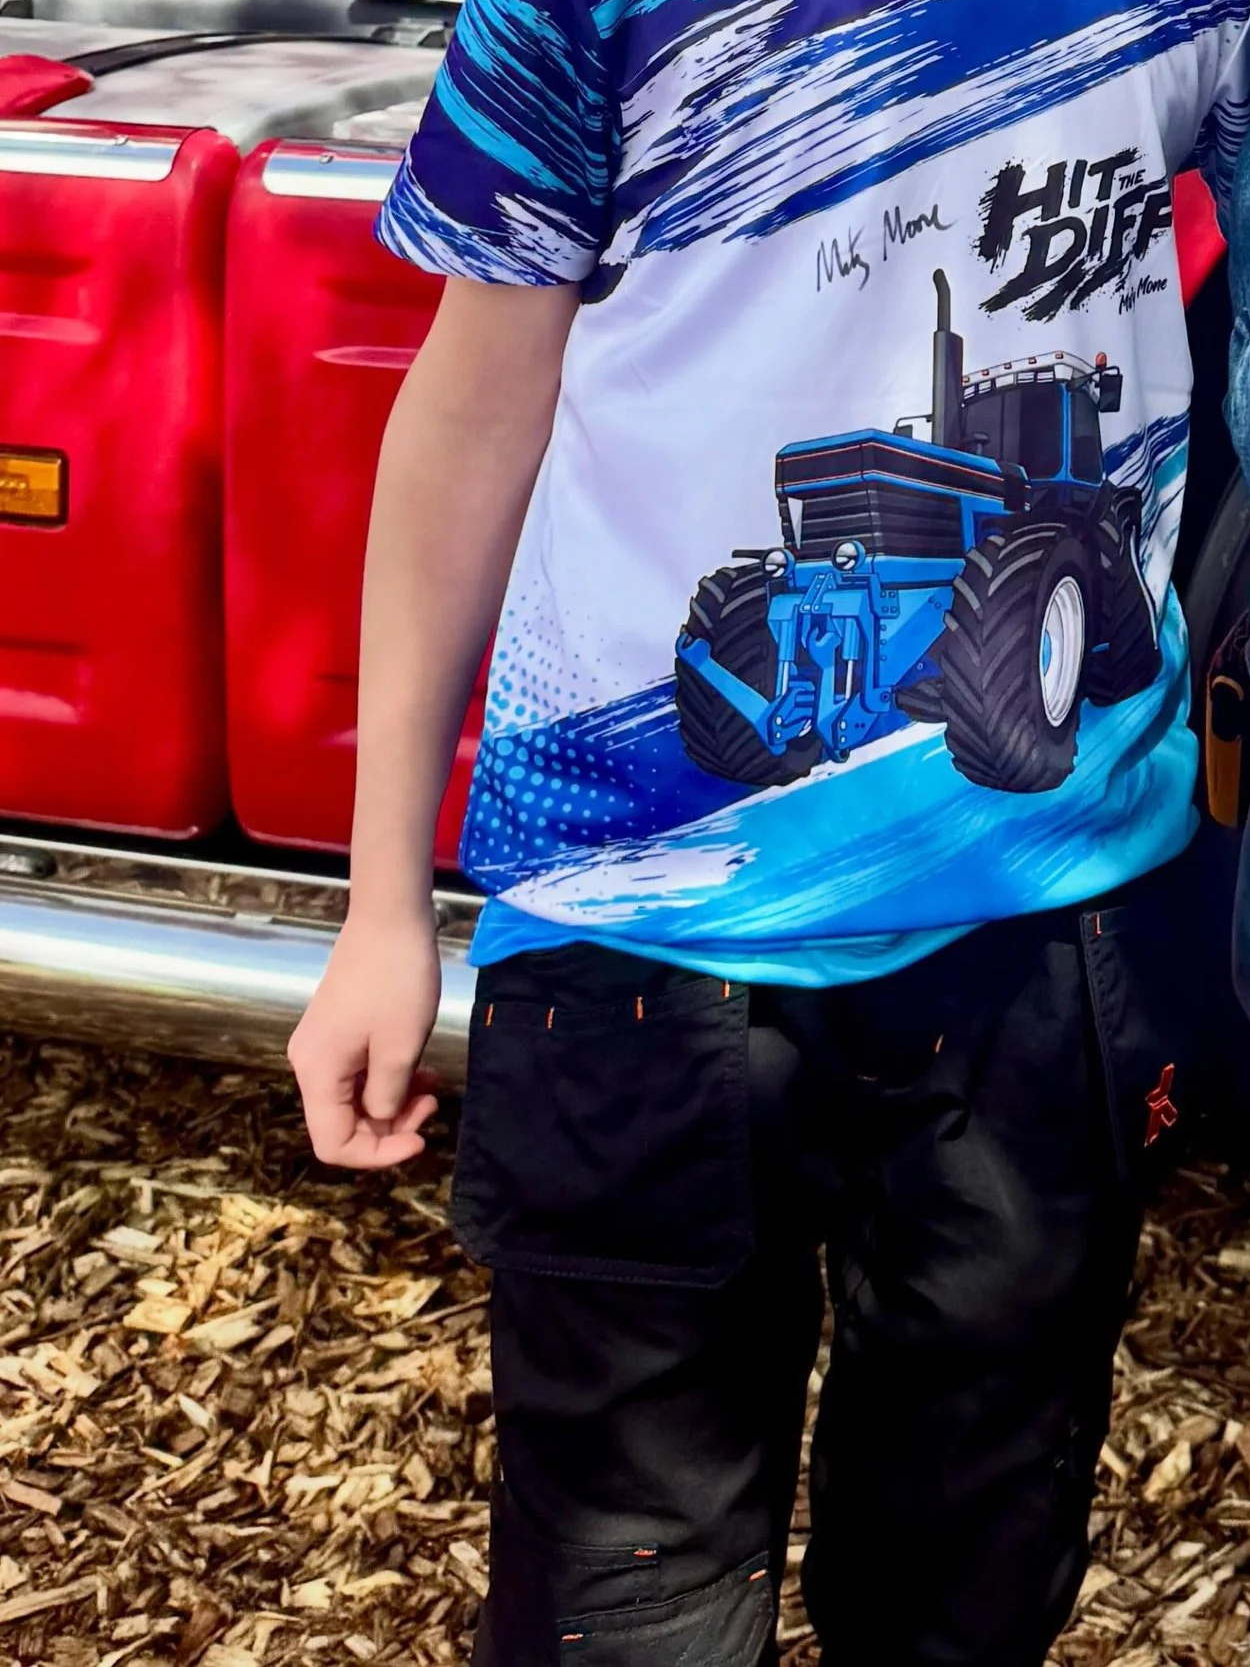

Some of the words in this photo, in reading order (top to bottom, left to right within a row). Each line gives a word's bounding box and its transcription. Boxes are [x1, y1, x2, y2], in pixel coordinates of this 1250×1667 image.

[974, 148, 1138, 273] HIT
[1118, 169, 1147, 191] THE
[978, 179, 1173, 323] DIFF
